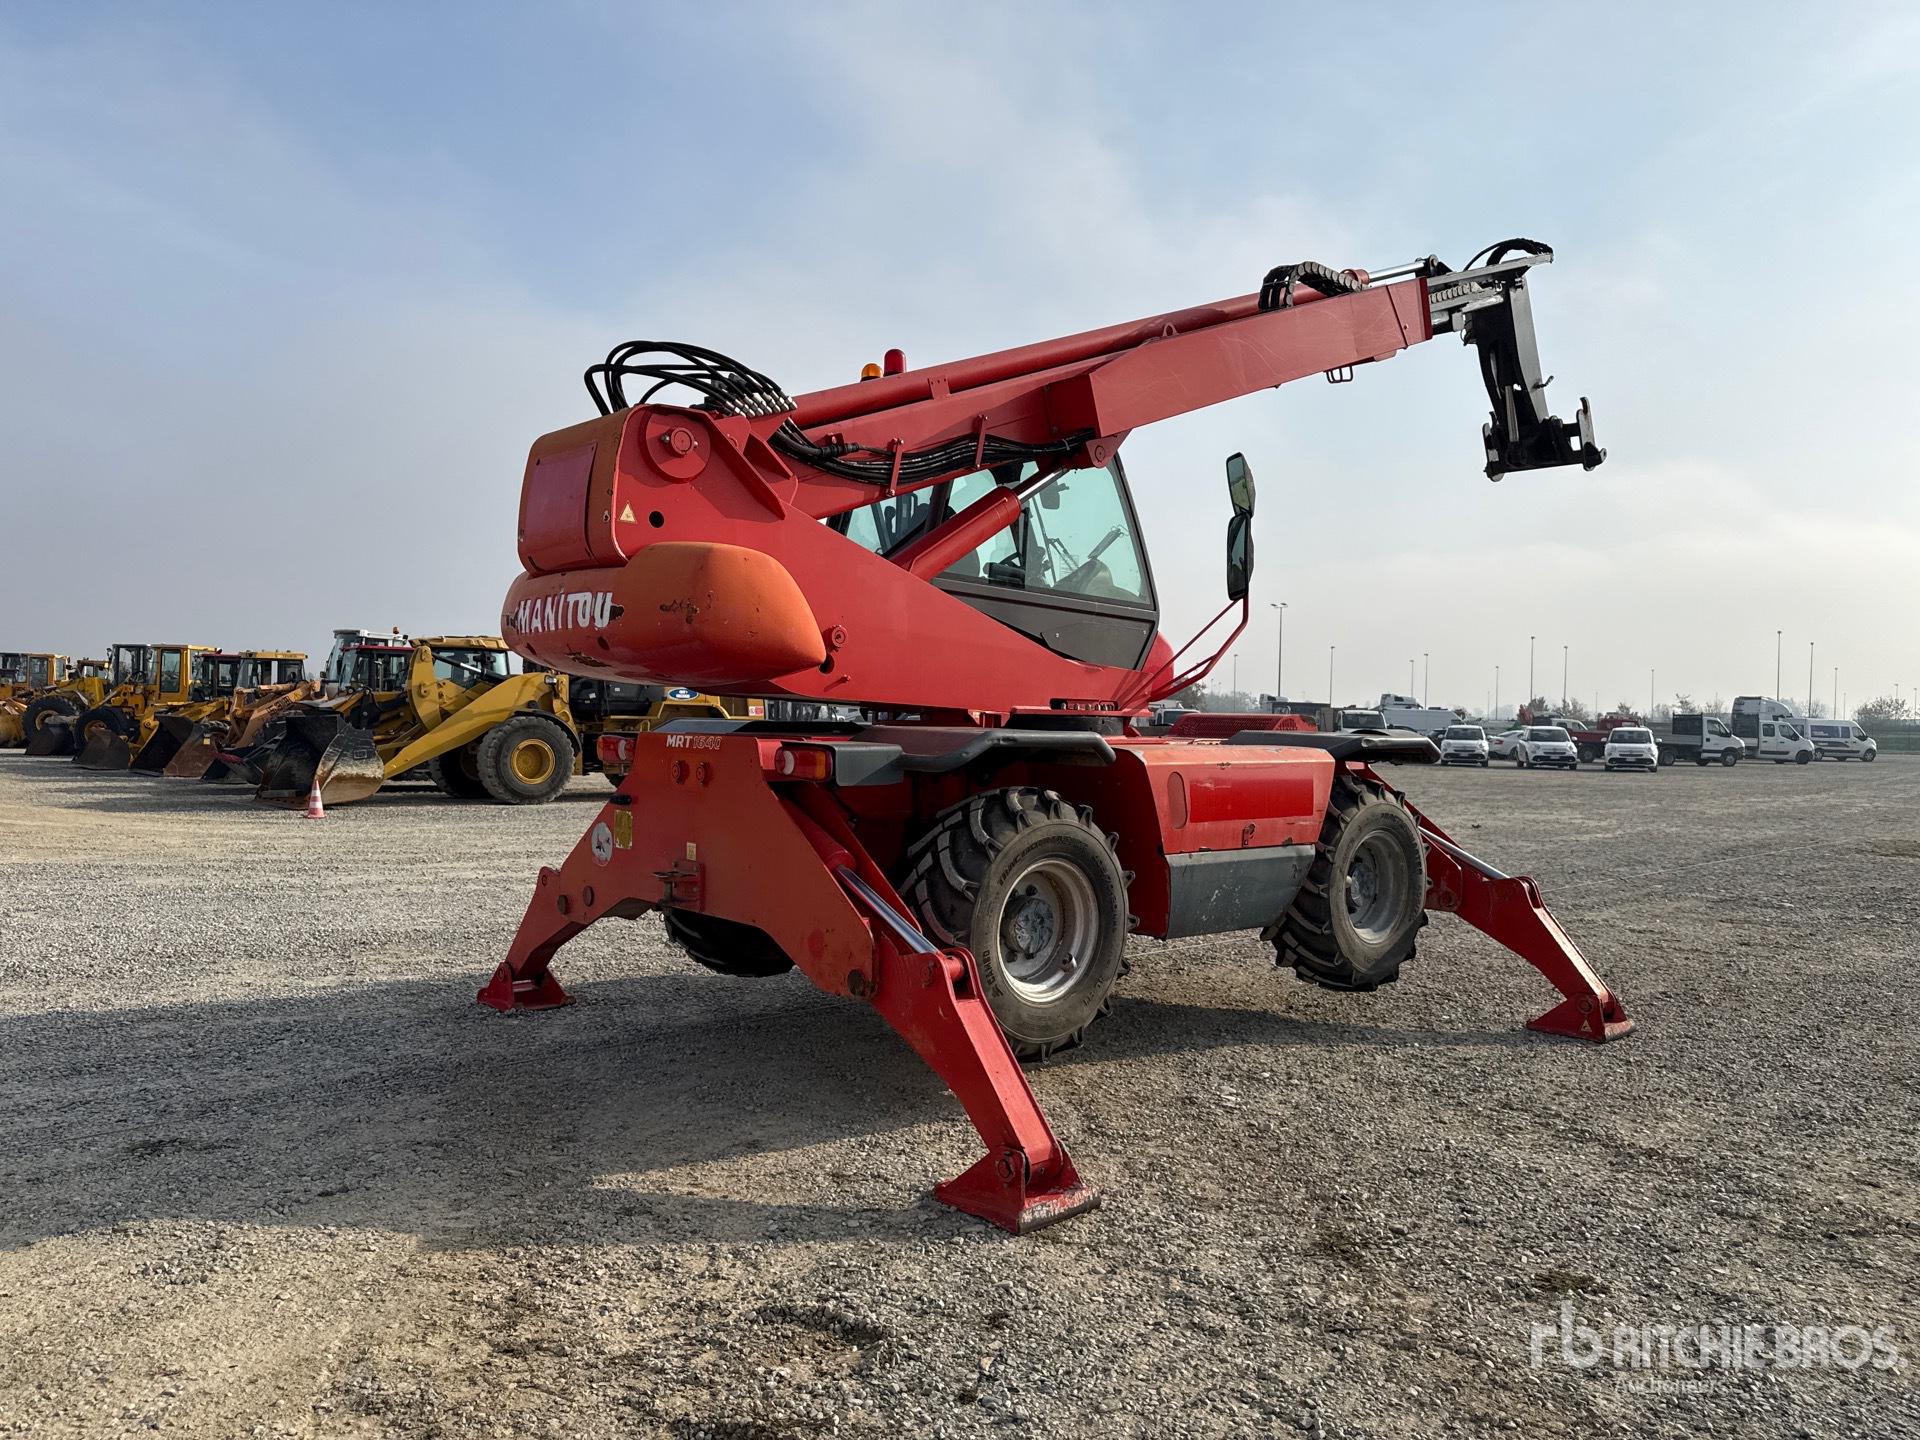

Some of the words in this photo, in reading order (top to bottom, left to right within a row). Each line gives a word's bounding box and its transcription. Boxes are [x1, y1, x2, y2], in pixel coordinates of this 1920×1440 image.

[517, 590, 613, 634] MANITOU
[665, 734, 694, 749] MRT
[692, 735, 723, 751] 1640
